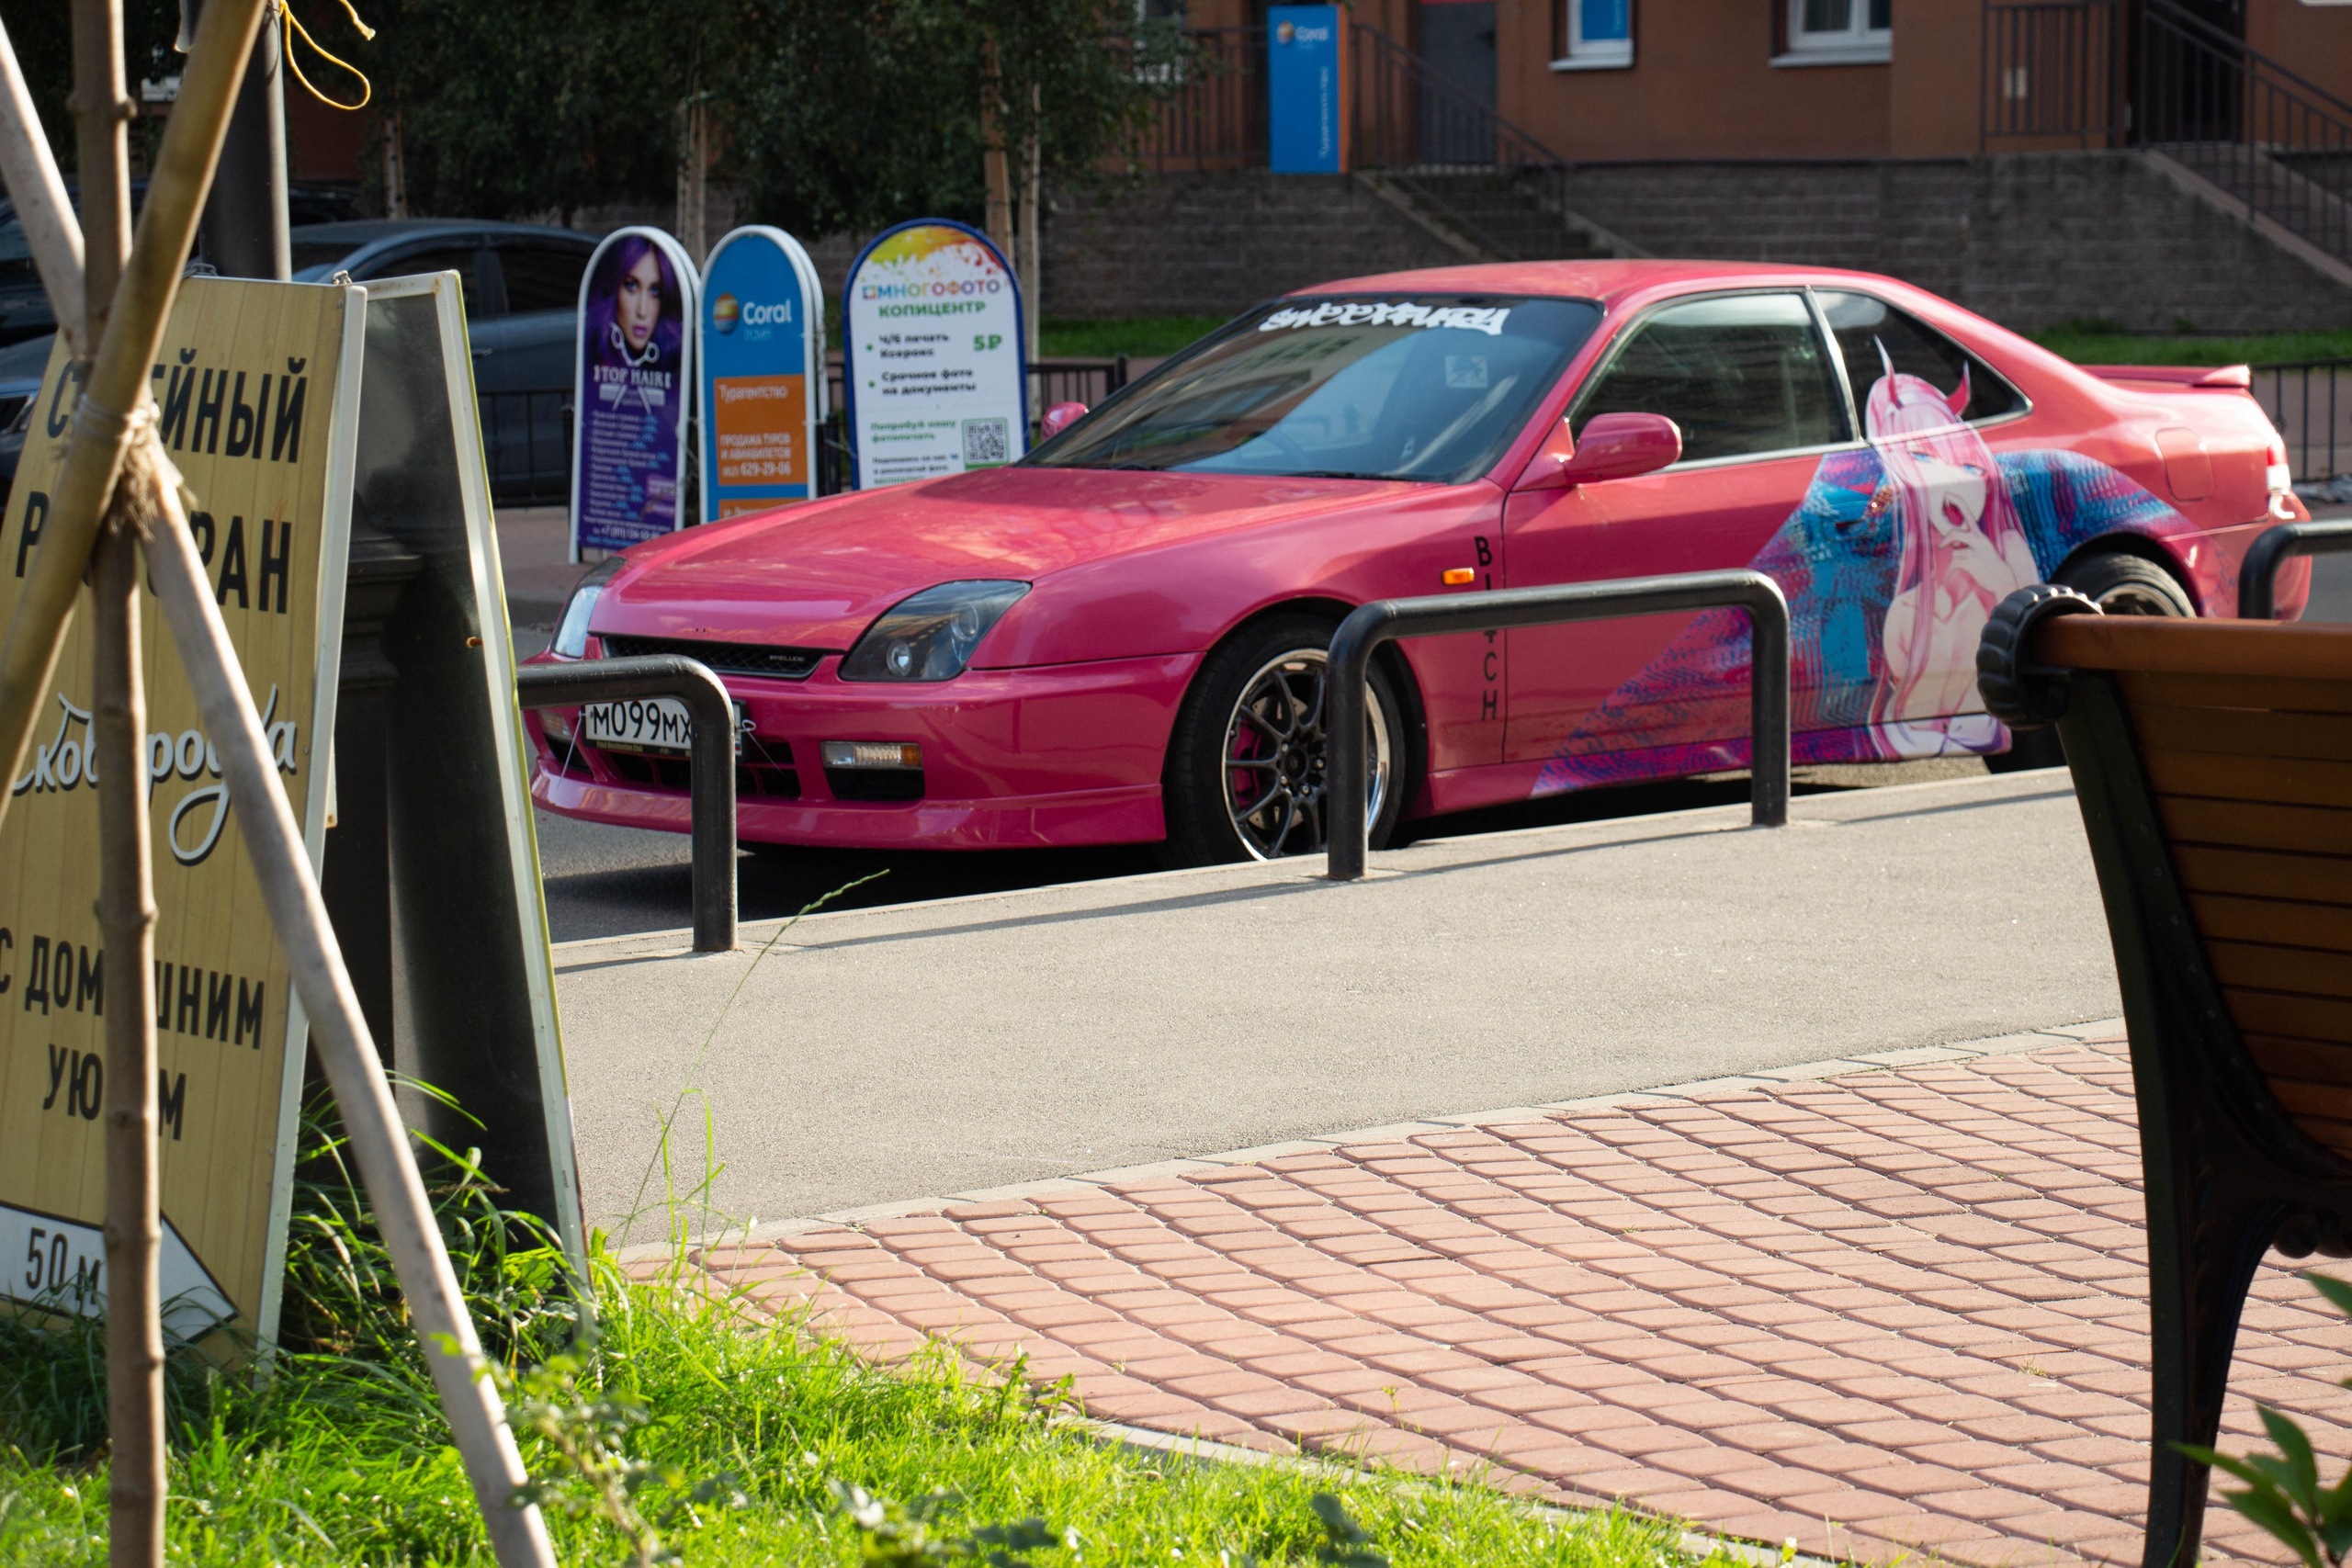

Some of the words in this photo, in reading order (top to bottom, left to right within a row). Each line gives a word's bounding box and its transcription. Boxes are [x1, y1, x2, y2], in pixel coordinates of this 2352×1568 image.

[877, 279, 1001, 298] МНОГОФОТО
[743, 299, 792, 325] Coral
[879, 300, 986, 318] КОПИЦЕНТР
[905, 333, 949, 344] печать
[880, 348, 934, 359] Ксерокс
[882, 370, 936, 382] Срочное
[942, 368, 974, 379] фото
[719, 384, 789, 403] Турагентство
[883, 387, 898, 395] на
[901, 383, 977, 396] документы
[720, 434, 762, 447] ПРОДАЖА
[763, 432, 792, 445] ТУРОВ
[721, 448, 729, 460] И
[25, 935, 265, 1050] ДОМШНИМ
[43, 1043, 187, 1141] УЮМ
[27, 1226, 68, 1295] 50
